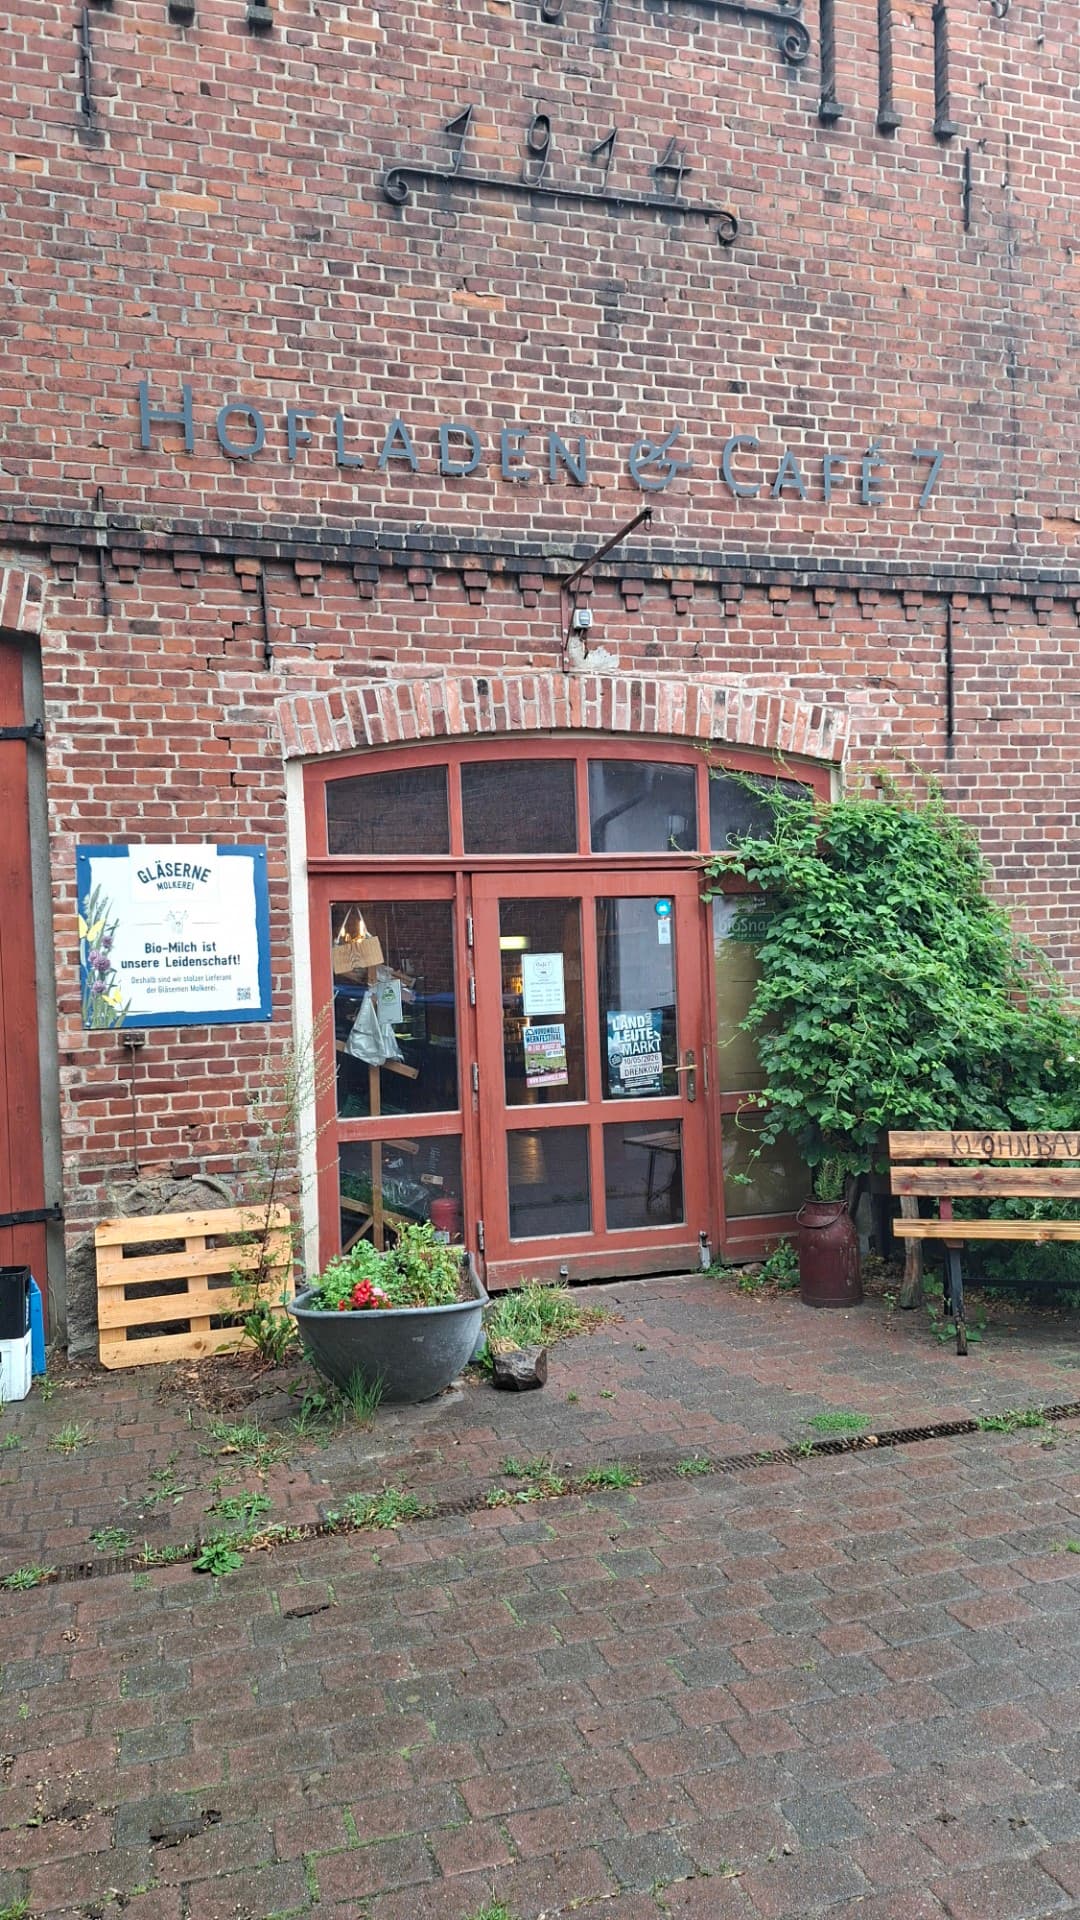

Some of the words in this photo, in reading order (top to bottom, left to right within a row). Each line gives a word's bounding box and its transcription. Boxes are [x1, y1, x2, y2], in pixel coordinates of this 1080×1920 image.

[446, 104, 691, 204] 1914
[139, 381, 587, 484] HOFLADEN
[629, 424, 692, 490] &
[722, 435, 886, 504] CAFÉ
[912, 447, 945, 508] 7
[137, 860, 212, 884] GLÄSERNE
[156, 881, 195, 891] MOLKEREI
[144, 941, 197, 954] Bio-Milch
[202, 941, 217, 952] ist
[121, 958, 160, 969] unsere
[165, 954, 241, 968] Leidenschaft!
[131, 976, 156, 985] Deshalb
[158, 975, 171, 983] sind
[612, 1014, 645, 1031] LAND
[617, 1027, 654, 1043] LEUTE
[622, 1039, 661, 1056] MARKT
